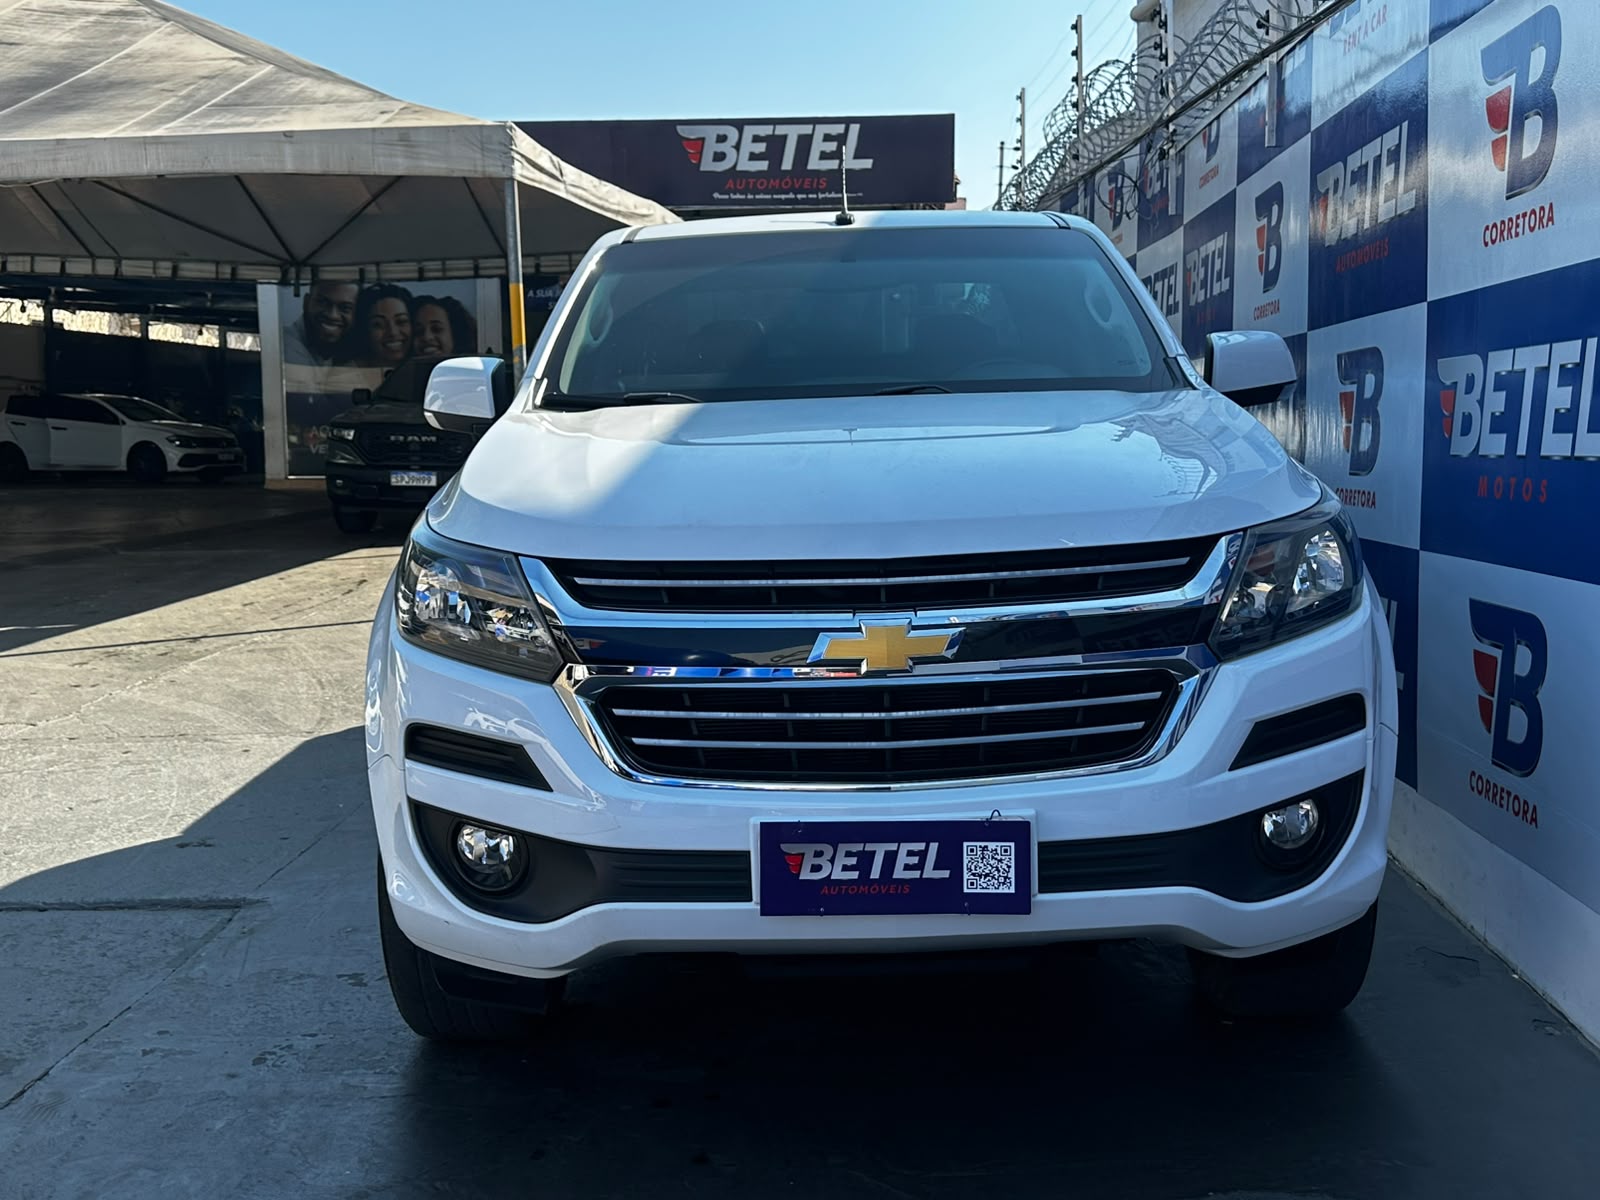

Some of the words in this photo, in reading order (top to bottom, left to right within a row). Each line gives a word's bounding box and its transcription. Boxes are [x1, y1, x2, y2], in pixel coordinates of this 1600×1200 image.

[1371, 4, 1388, 33] CAR
[676, 124, 874, 172] BETEL
[725, 176, 828, 190] AUTOMÓVEIS
[1316, 120, 1417, 247] BETEL
[1482, 202, 1555, 248] CORRETORA
[1185, 231, 1231, 307] BETEL
[1437, 336, 1600, 459] BETEL
[390, 435, 437, 443] RAM
[1477, 475, 1548, 503] MOTOS
[1469, 770, 1539, 829] CORRETORA
[780, 842, 951, 880] BETEL
[820, 883, 912, 895] AUTOMÓVEIS
